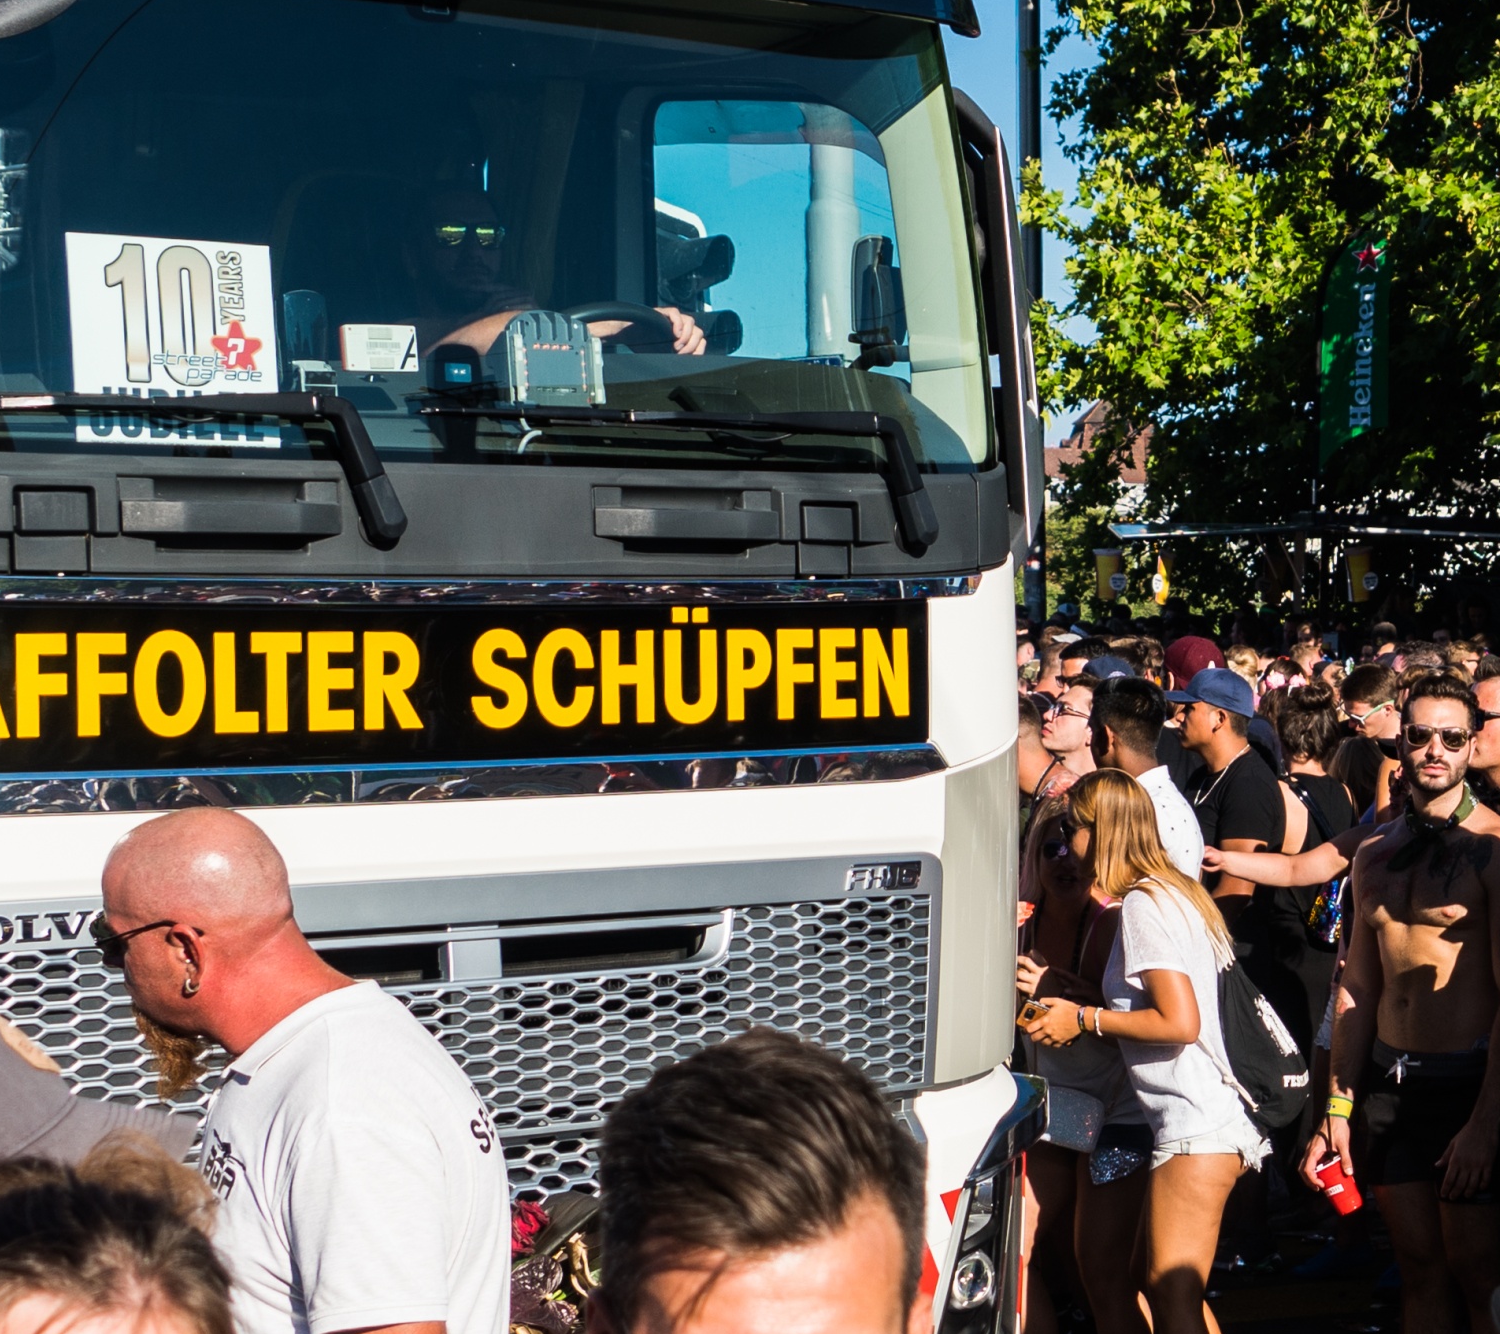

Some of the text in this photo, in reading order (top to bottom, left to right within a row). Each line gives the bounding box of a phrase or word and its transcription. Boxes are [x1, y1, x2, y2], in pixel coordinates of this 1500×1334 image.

[104, 242, 216, 388] 10
[216, 250, 246, 325] YEARS
[152, 350, 228, 367] street
[185, 364, 263, 385] parade
[1349, 282, 1376, 427] Heineken
[470, 606, 912, 730] SCHÜPFEN
